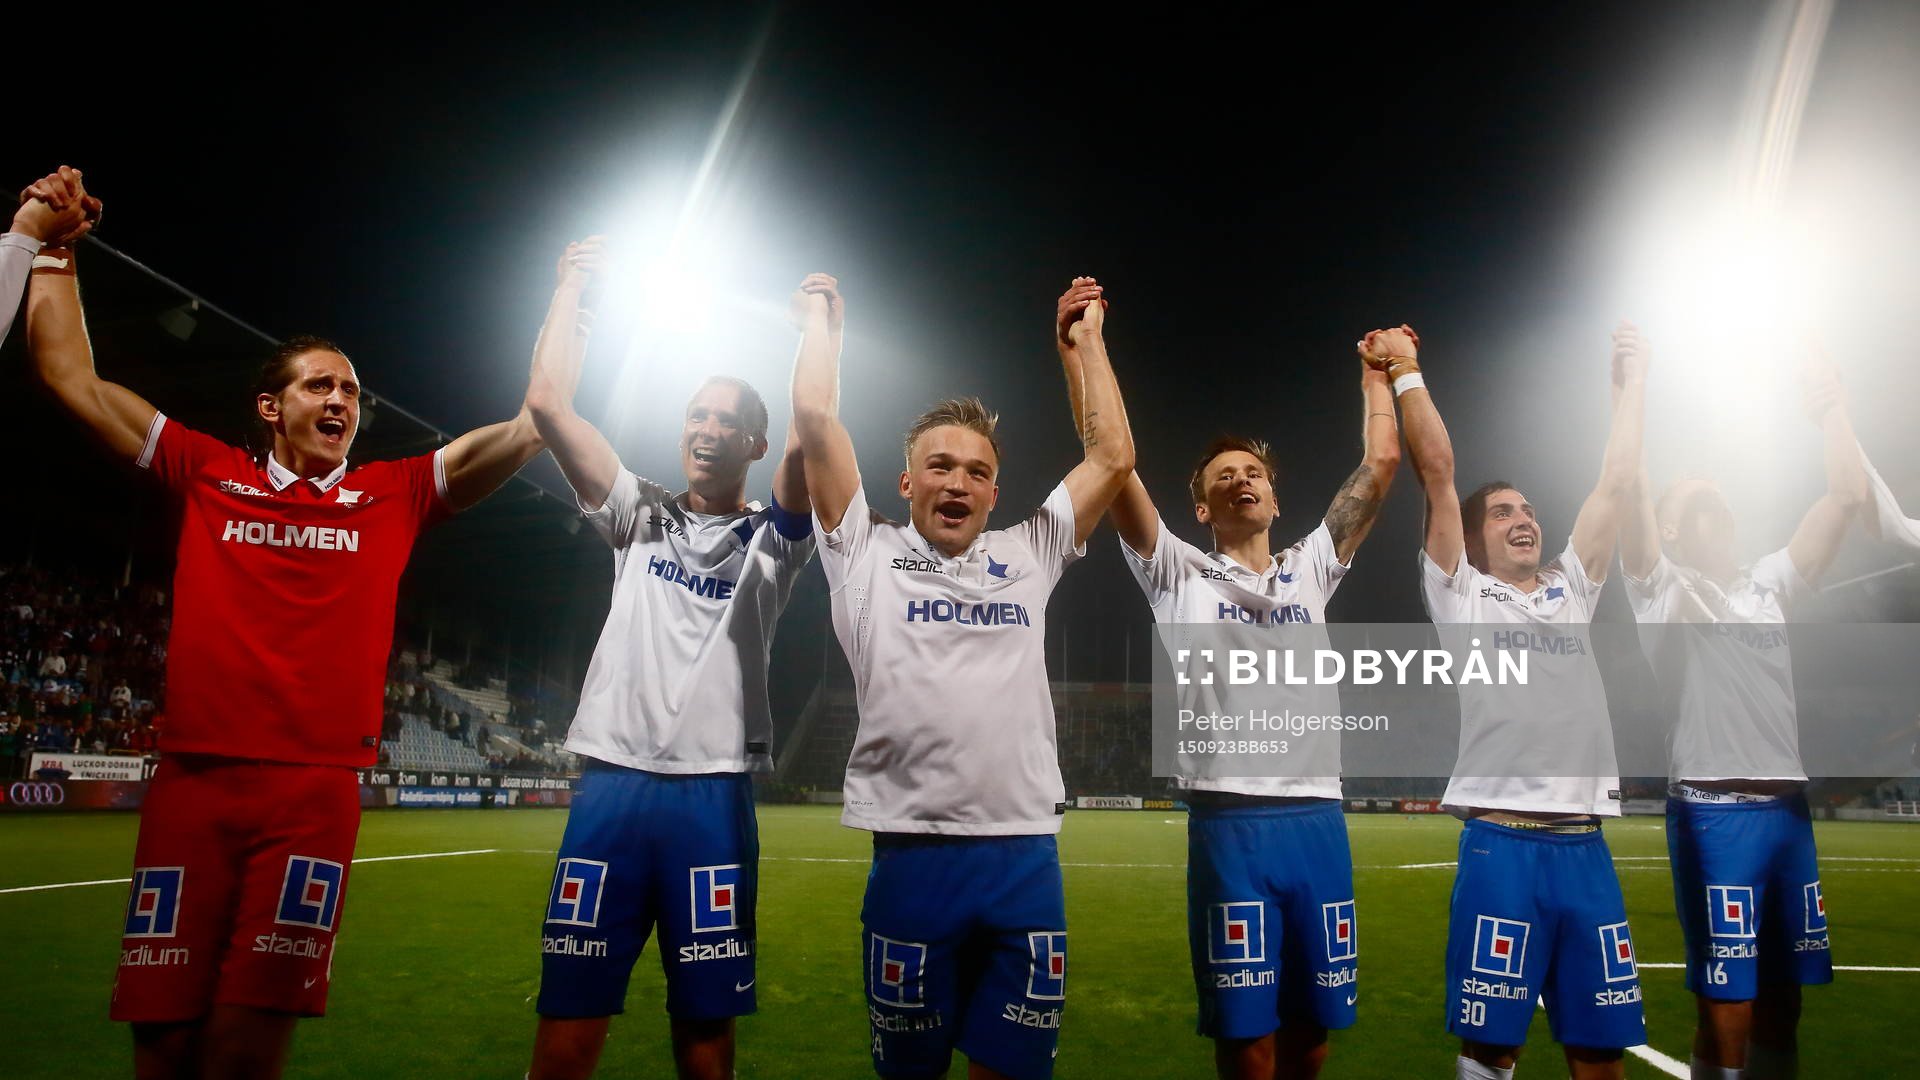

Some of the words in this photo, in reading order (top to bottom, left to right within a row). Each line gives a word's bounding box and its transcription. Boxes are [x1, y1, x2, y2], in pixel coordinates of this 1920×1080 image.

[222, 520, 359, 552] HOLMEN
[648, 554, 735, 600] HOLME
[907, 600, 1030, 627] HOLMEN
[1690, 788, 1720, 802] Klein
[1706, 961, 1728, 985] 16
[1462, 976, 1528, 1000] stadium
[1460, 998, 1486, 1026] 30
